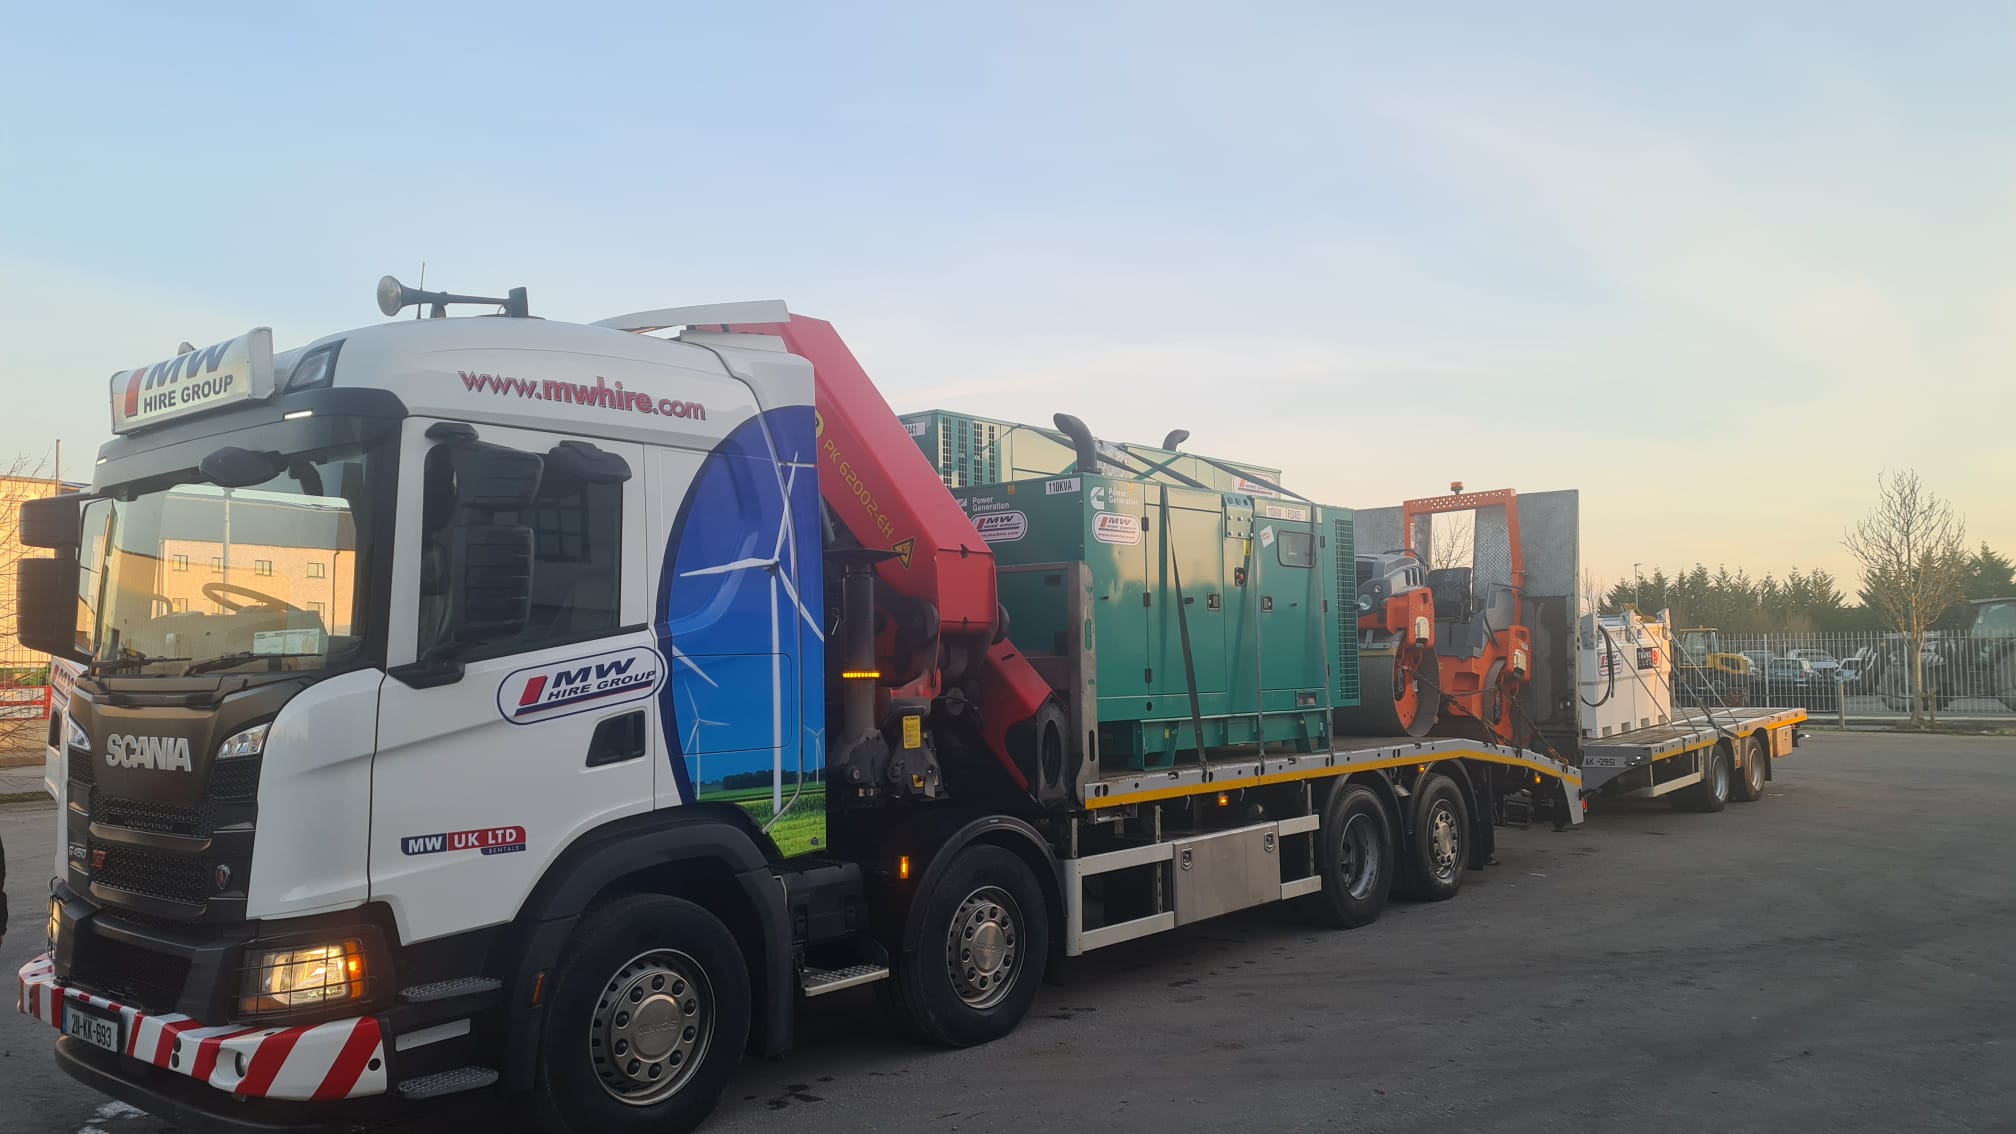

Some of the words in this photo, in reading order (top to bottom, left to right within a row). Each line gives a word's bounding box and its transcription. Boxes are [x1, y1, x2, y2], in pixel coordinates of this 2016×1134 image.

[145, 337, 237, 391] MW
[143, 389, 177, 414] HIRE
[181, 374, 234, 403] GROUP
[457, 370, 706, 421] www.mwhire.com
[823, 439, 841, 464] PK
[839, 462, 895, 538] 62002-EH
[1048, 479, 1073, 493] 110KVA
[972, 496, 994, 505] Power
[972, 501, 1010, 512] Generation
[986, 515, 1015, 524] MW
[1108, 516, 1132, 526] MW
[547, 684, 592, 700] HIRE
[596, 671, 656, 690] GROUP
[552, 656, 637, 689] MW
[105, 733, 192, 773] SCANIA
[408, 836, 443, 854] MW
[453, 831, 480, 848] UK
[487, 828, 517, 845] LTD
[488, 844, 520, 854] RENTALS
